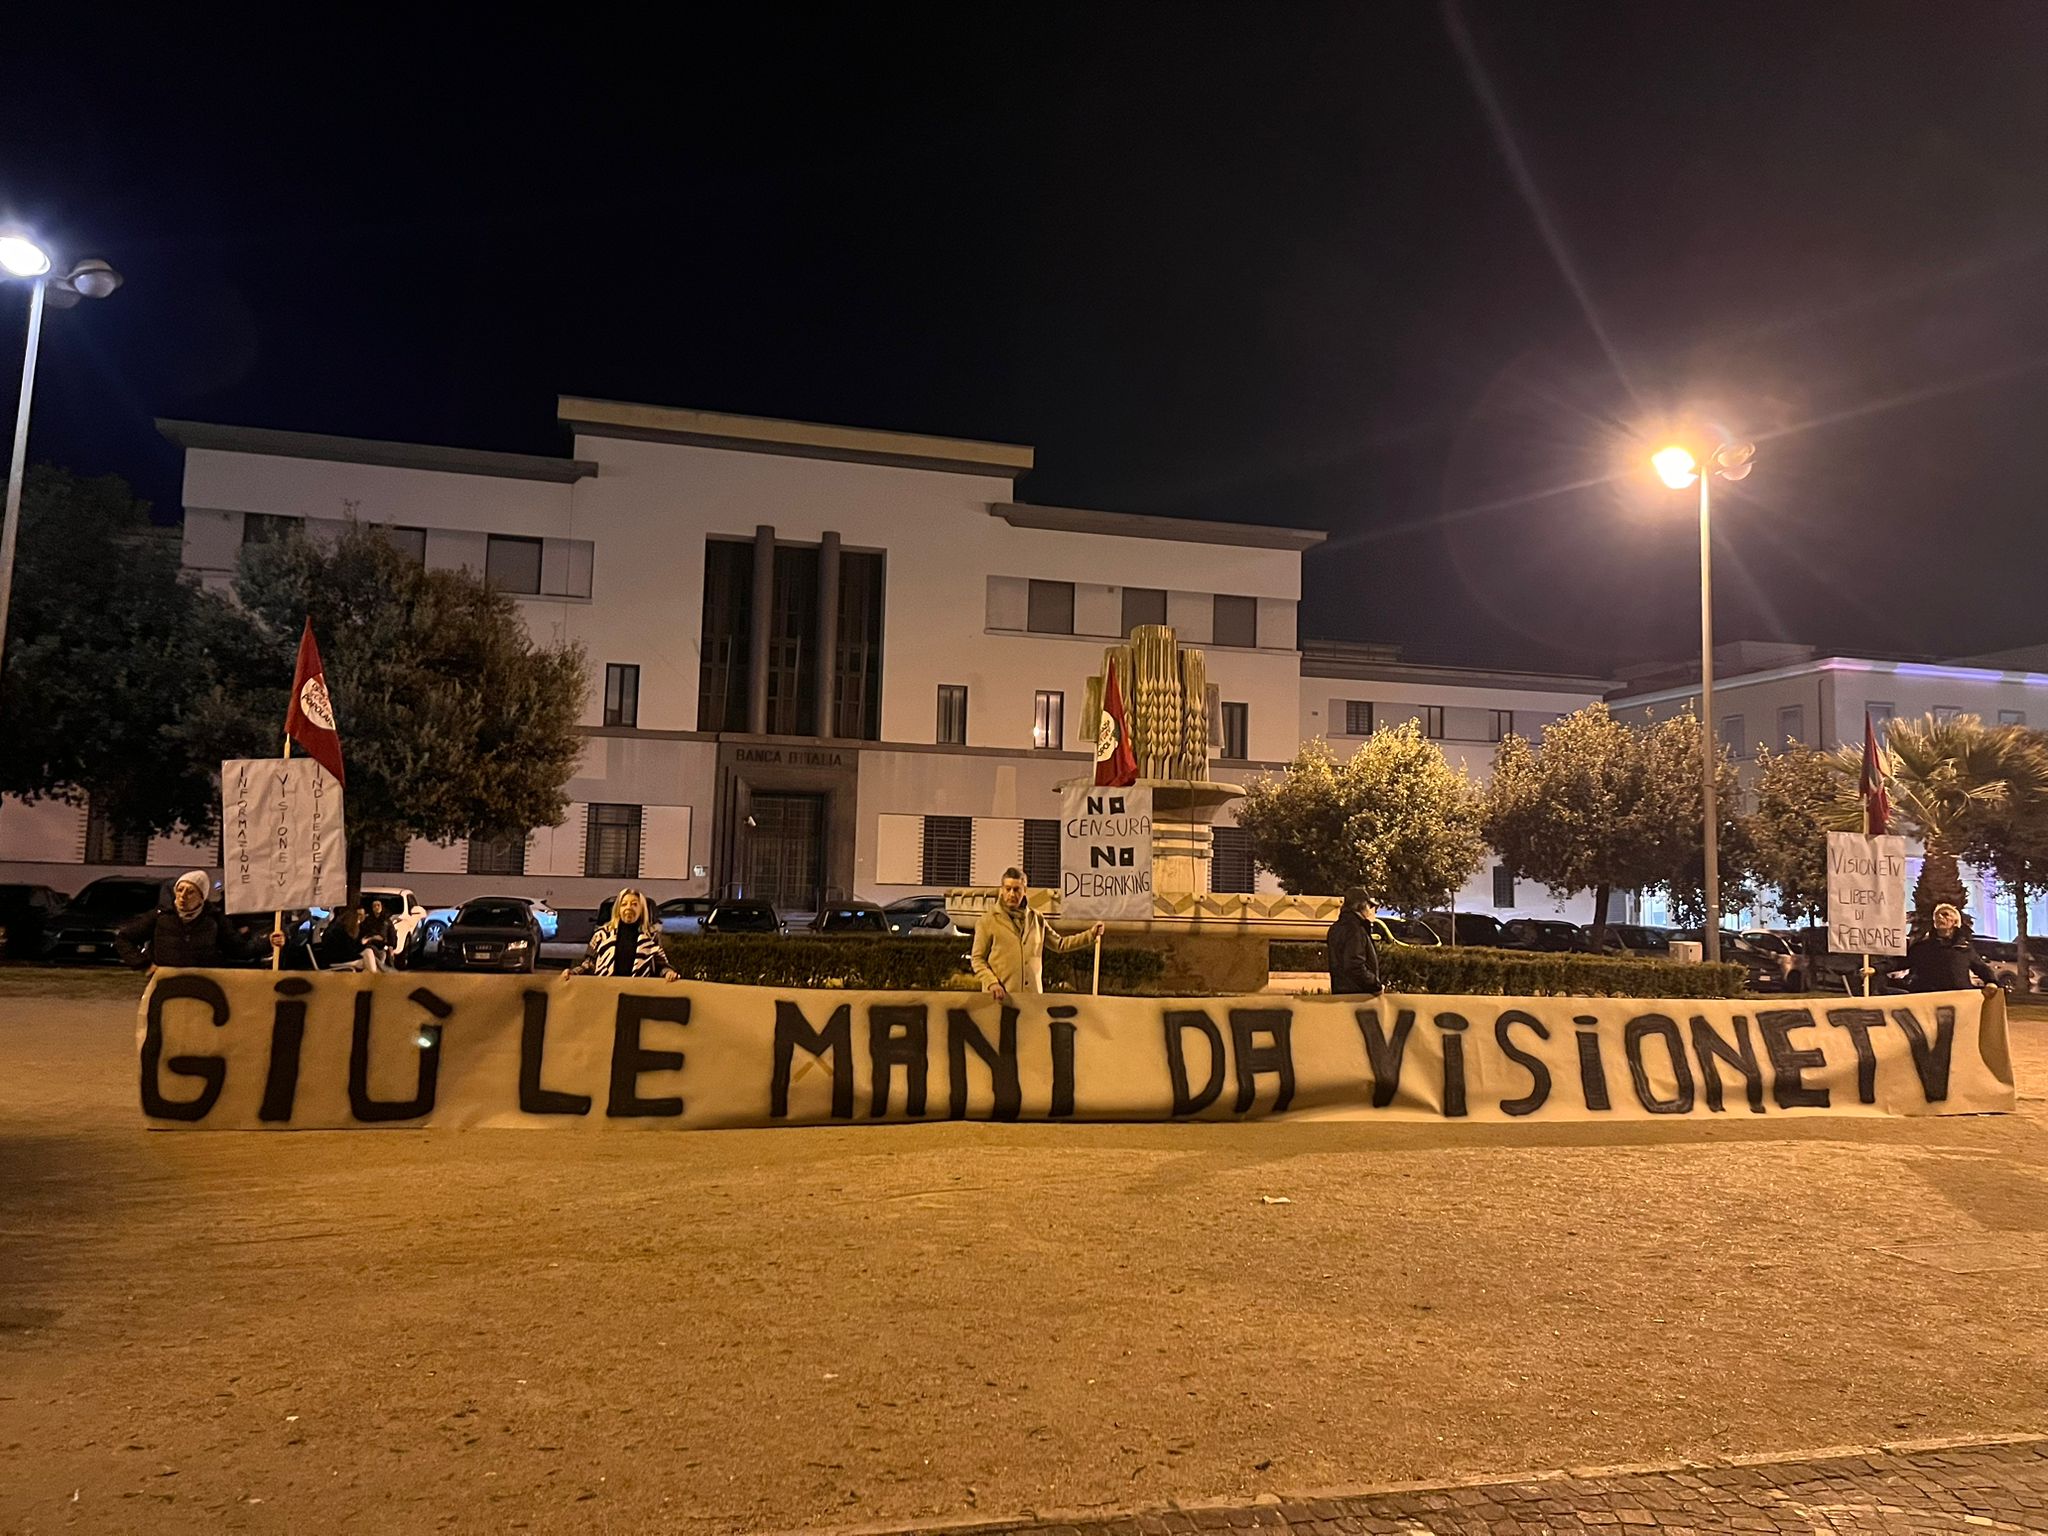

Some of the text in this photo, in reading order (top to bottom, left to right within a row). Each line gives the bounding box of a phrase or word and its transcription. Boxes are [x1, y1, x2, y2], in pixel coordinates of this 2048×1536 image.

[736, 749, 782, 763] BANCA
[1087, 796, 1125, 815] NO
[237, 766, 250, 884] INFORMAZIONE
[276, 773, 289, 887] VISIONE TV
[312, 763, 324, 896] INDIPENDENTE
[1067, 815, 1151, 838] CENSURA
[1090, 846, 1134, 868] NO
[1065, 871, 1150, 897] DEBANKING
[1839, 889, 1886, 905] LIBERA
[1855, 910, 1865, 920] DI
[1838, 924, 1901, 948] PENSARE
[519, 989, 691, 1117] LE
[1163, 1008, 1294, 1116] DA
